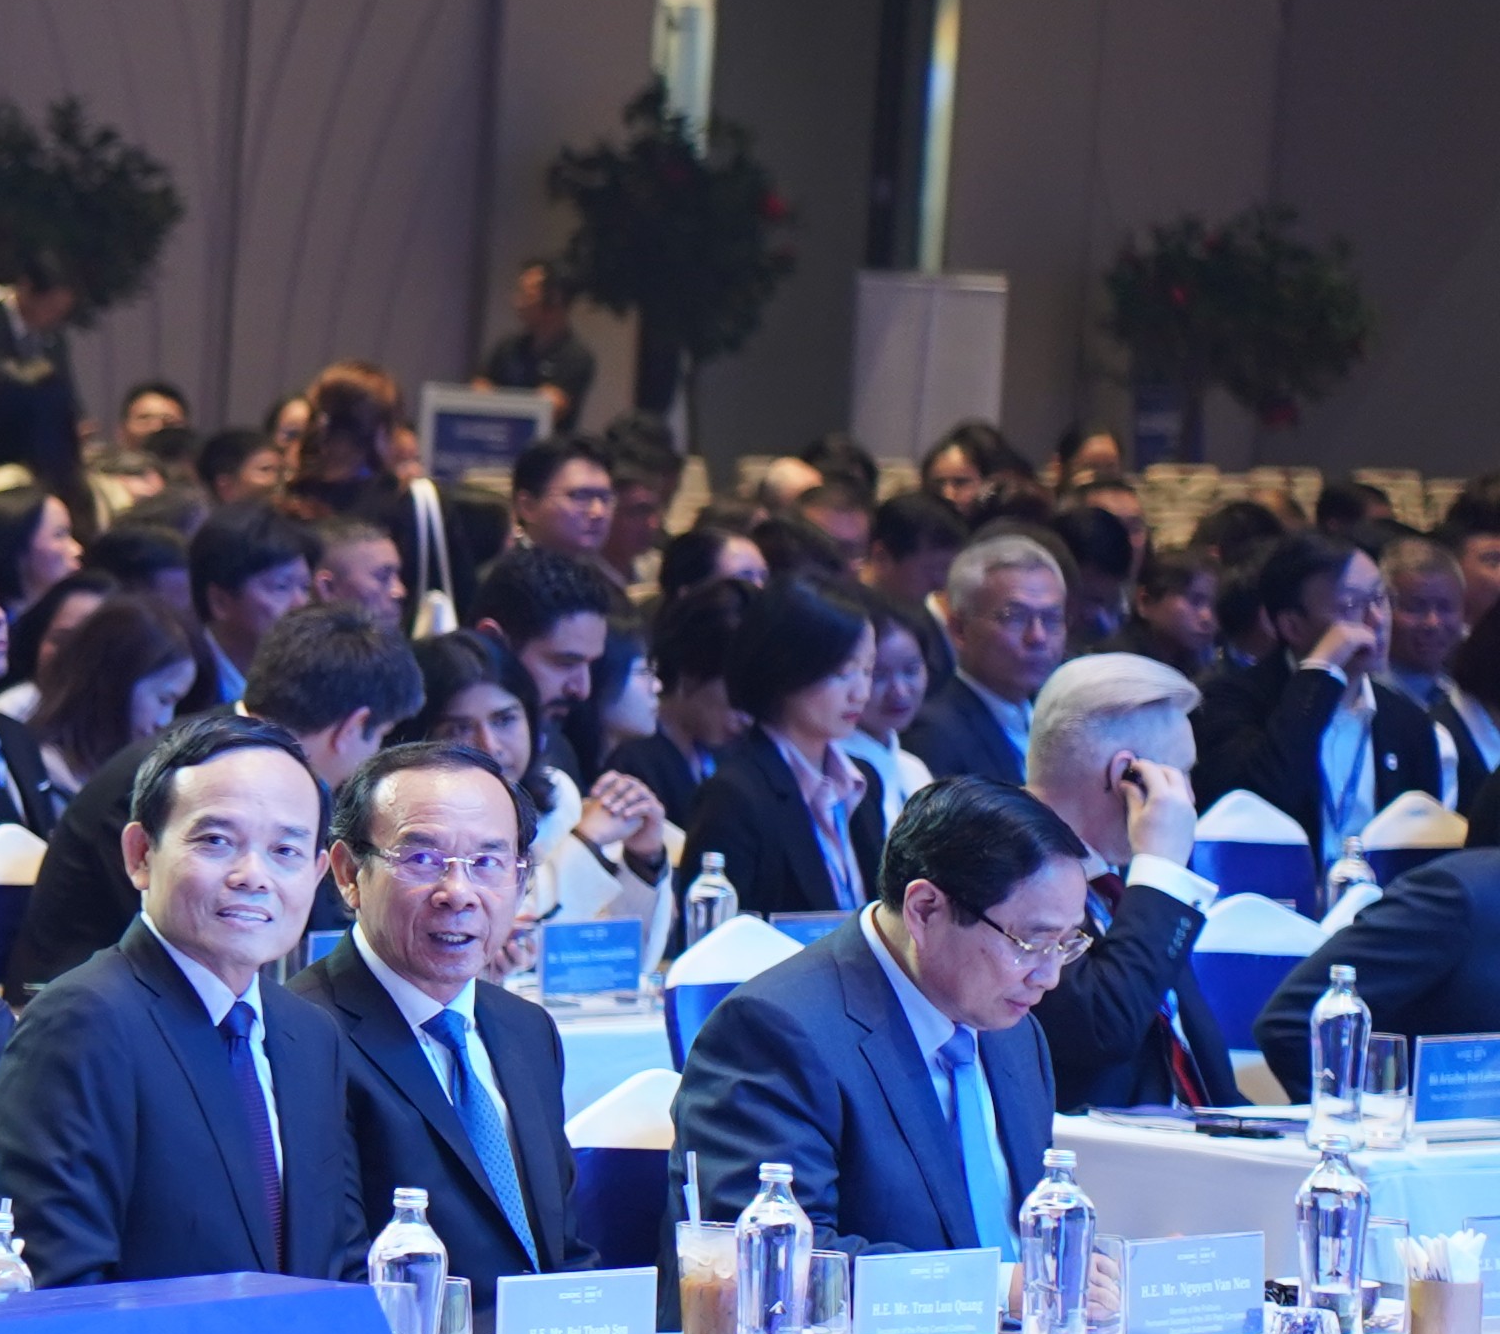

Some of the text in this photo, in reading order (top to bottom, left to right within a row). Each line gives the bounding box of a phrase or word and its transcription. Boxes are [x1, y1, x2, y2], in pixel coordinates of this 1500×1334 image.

[1162, 1283, 1177, 1296] Mr.
[1180, 1281, 1212, 1298] Nguyen
[1214, 1278, 1231, 1291] Van
[1233, 1277, 1251, 1290] Nen
[893, 1302, 910, 1315] Mr.
[912, 1301, 933, 1314] Tran
[935, 1300, 952, 1313] Luu
[954, 1299, 984, 1315] Quang
